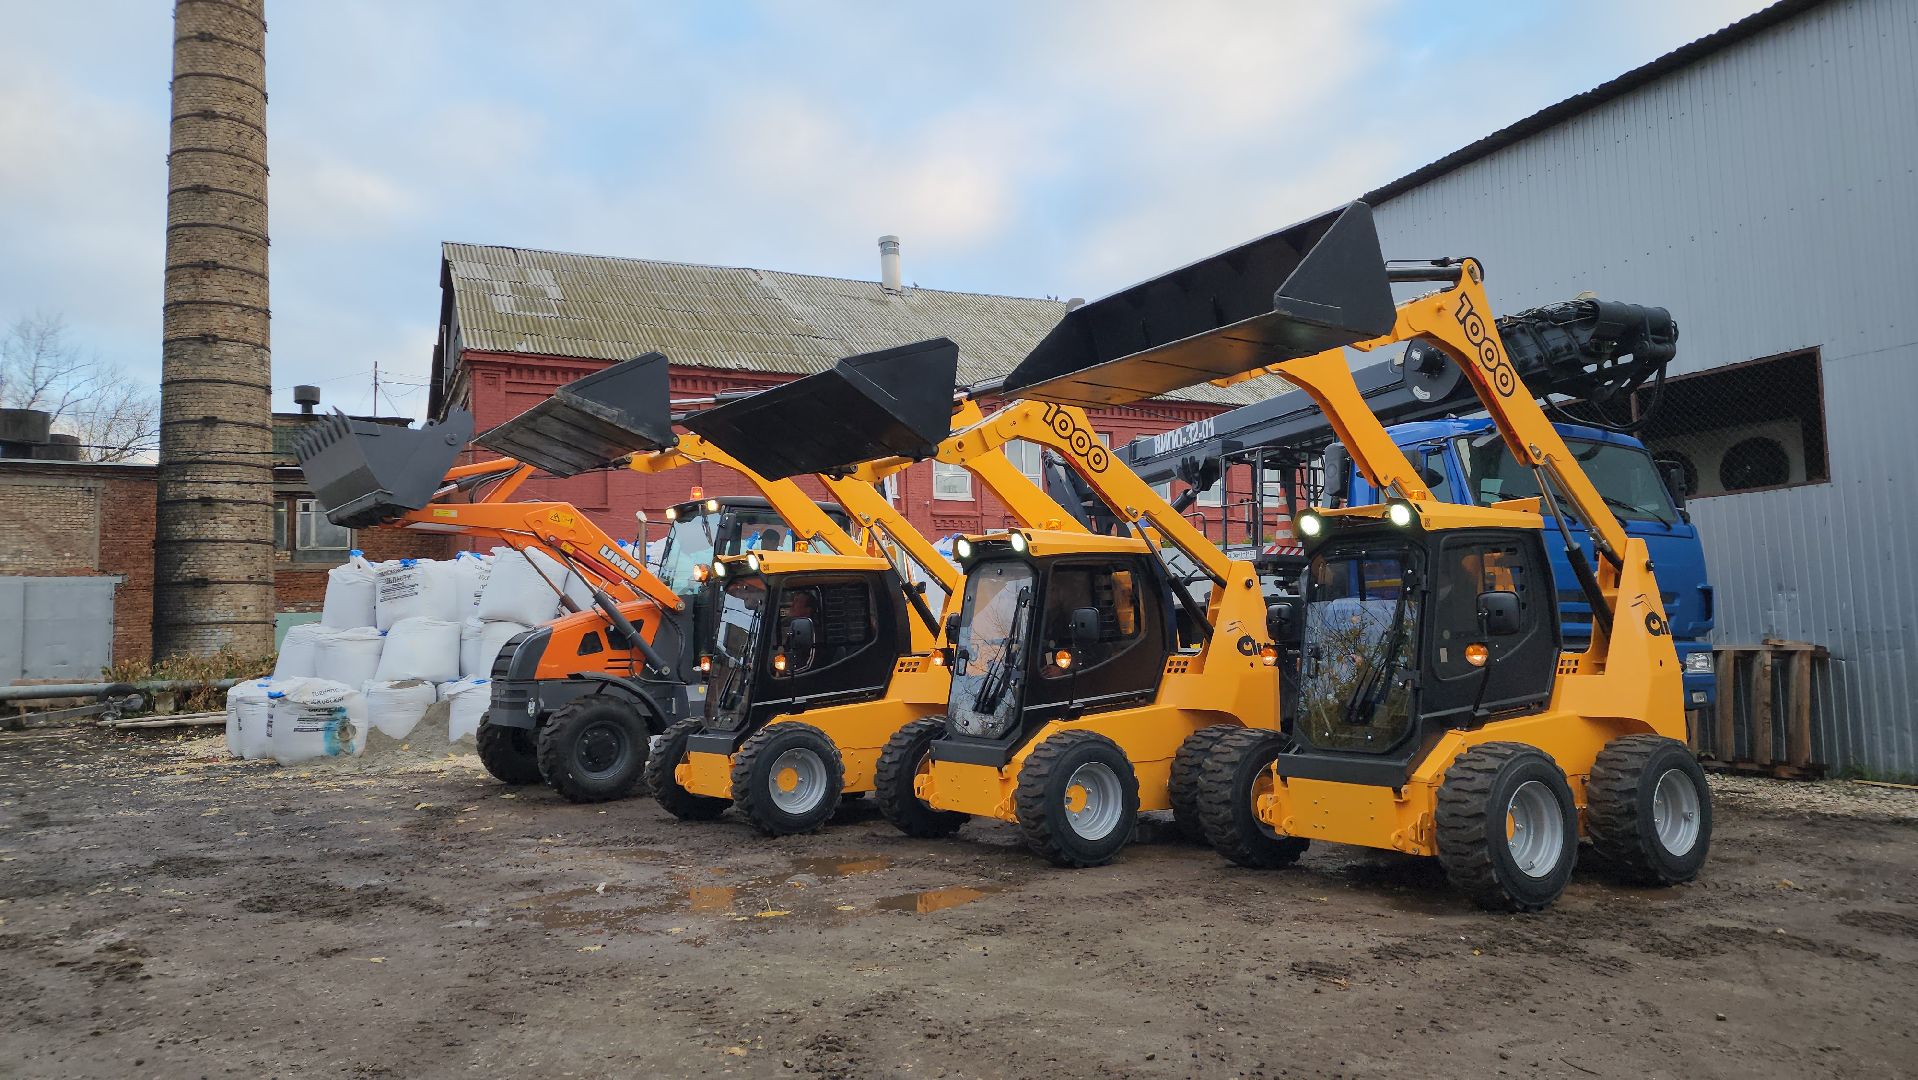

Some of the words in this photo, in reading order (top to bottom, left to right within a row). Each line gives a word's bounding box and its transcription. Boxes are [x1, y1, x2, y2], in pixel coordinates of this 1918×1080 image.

[1455, 291, 1516, 398] 1000
[1042, 401, 1109, 473] 1000
[598, 544, 641, 580] UMG
